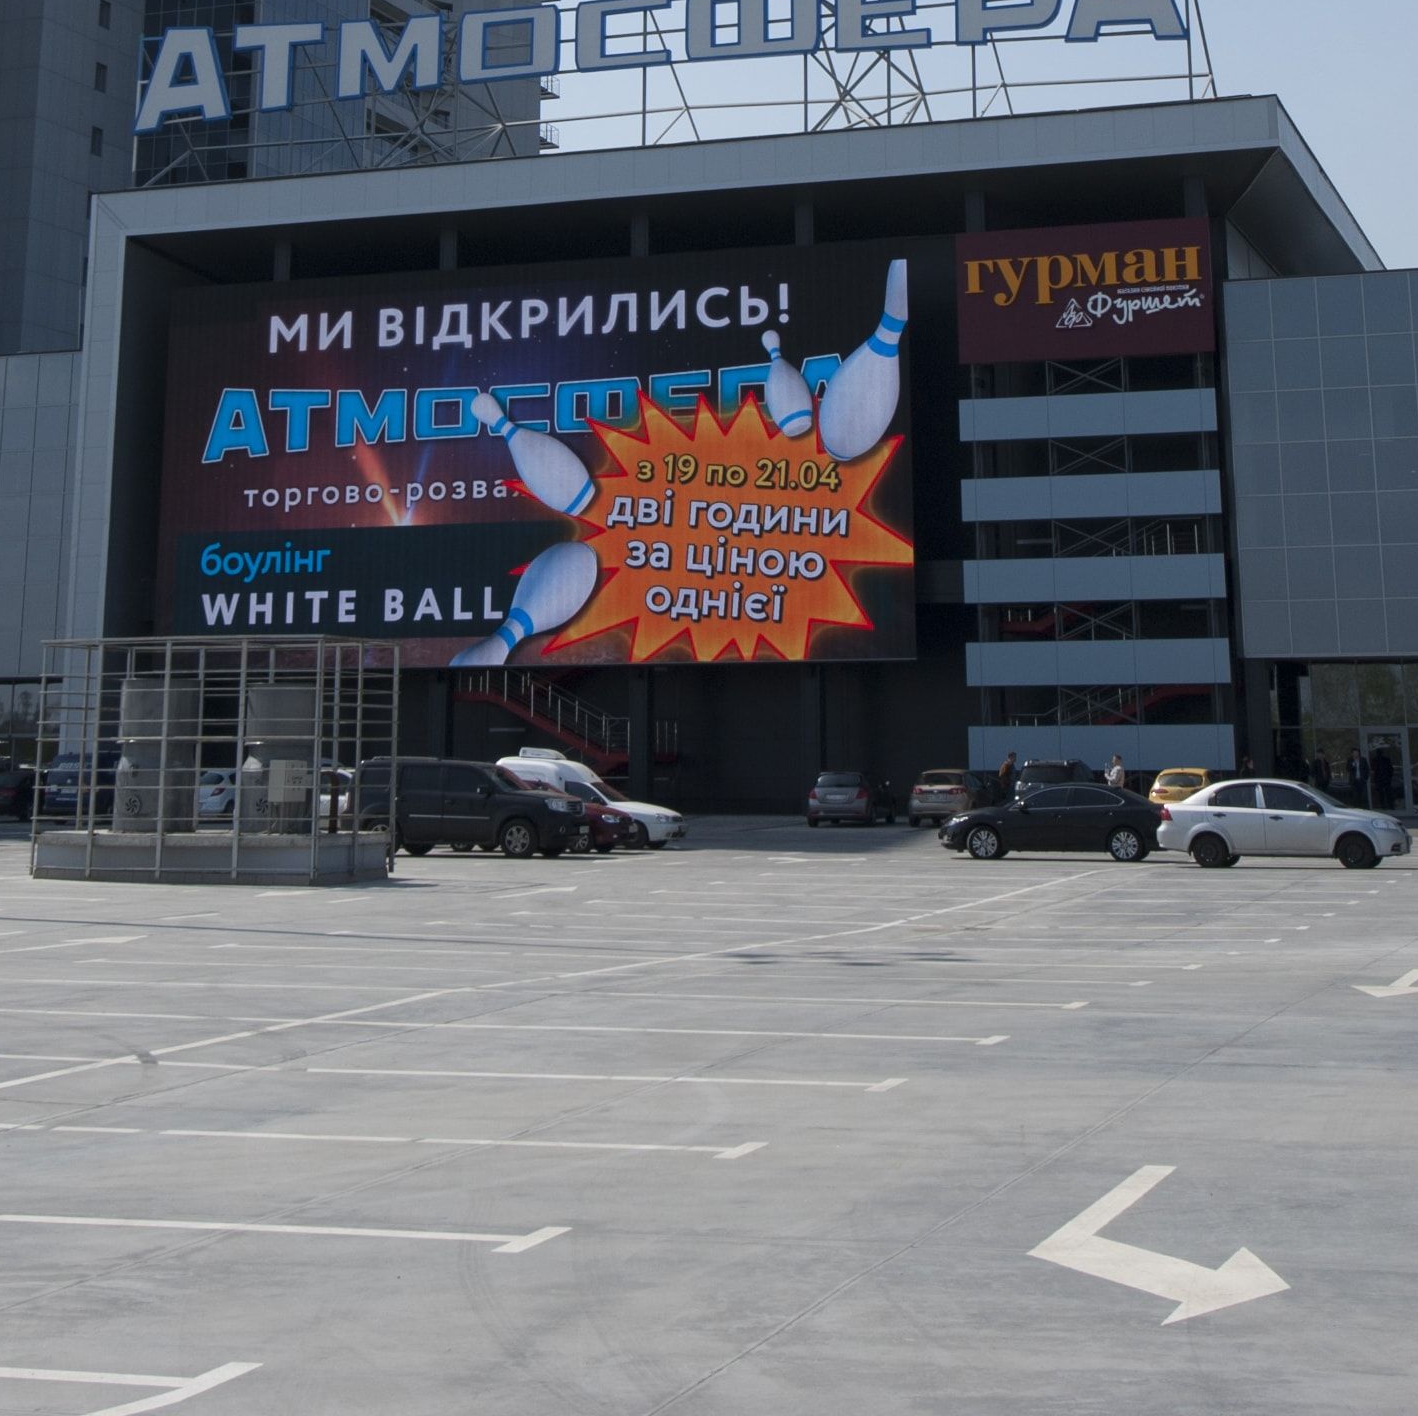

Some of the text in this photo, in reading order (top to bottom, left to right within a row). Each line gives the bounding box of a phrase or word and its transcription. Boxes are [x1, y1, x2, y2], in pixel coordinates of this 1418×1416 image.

[963, 246, 1203, 306] гурман
[268, 282, 790, 354] МИ ВІДКРИЛИСЬ!
[636, 453, 840, 490] з 19 по 21.04
[243, 479, 518, 513] торгово-розва
[606, 488, 849, 536] дві години
[200, 541, 331, 584] боулінг
[625, 536, 825, 579] за ціною
[201, 586, 503, 626] WHITE BALL
[644, 581, 786, 622] однієї
